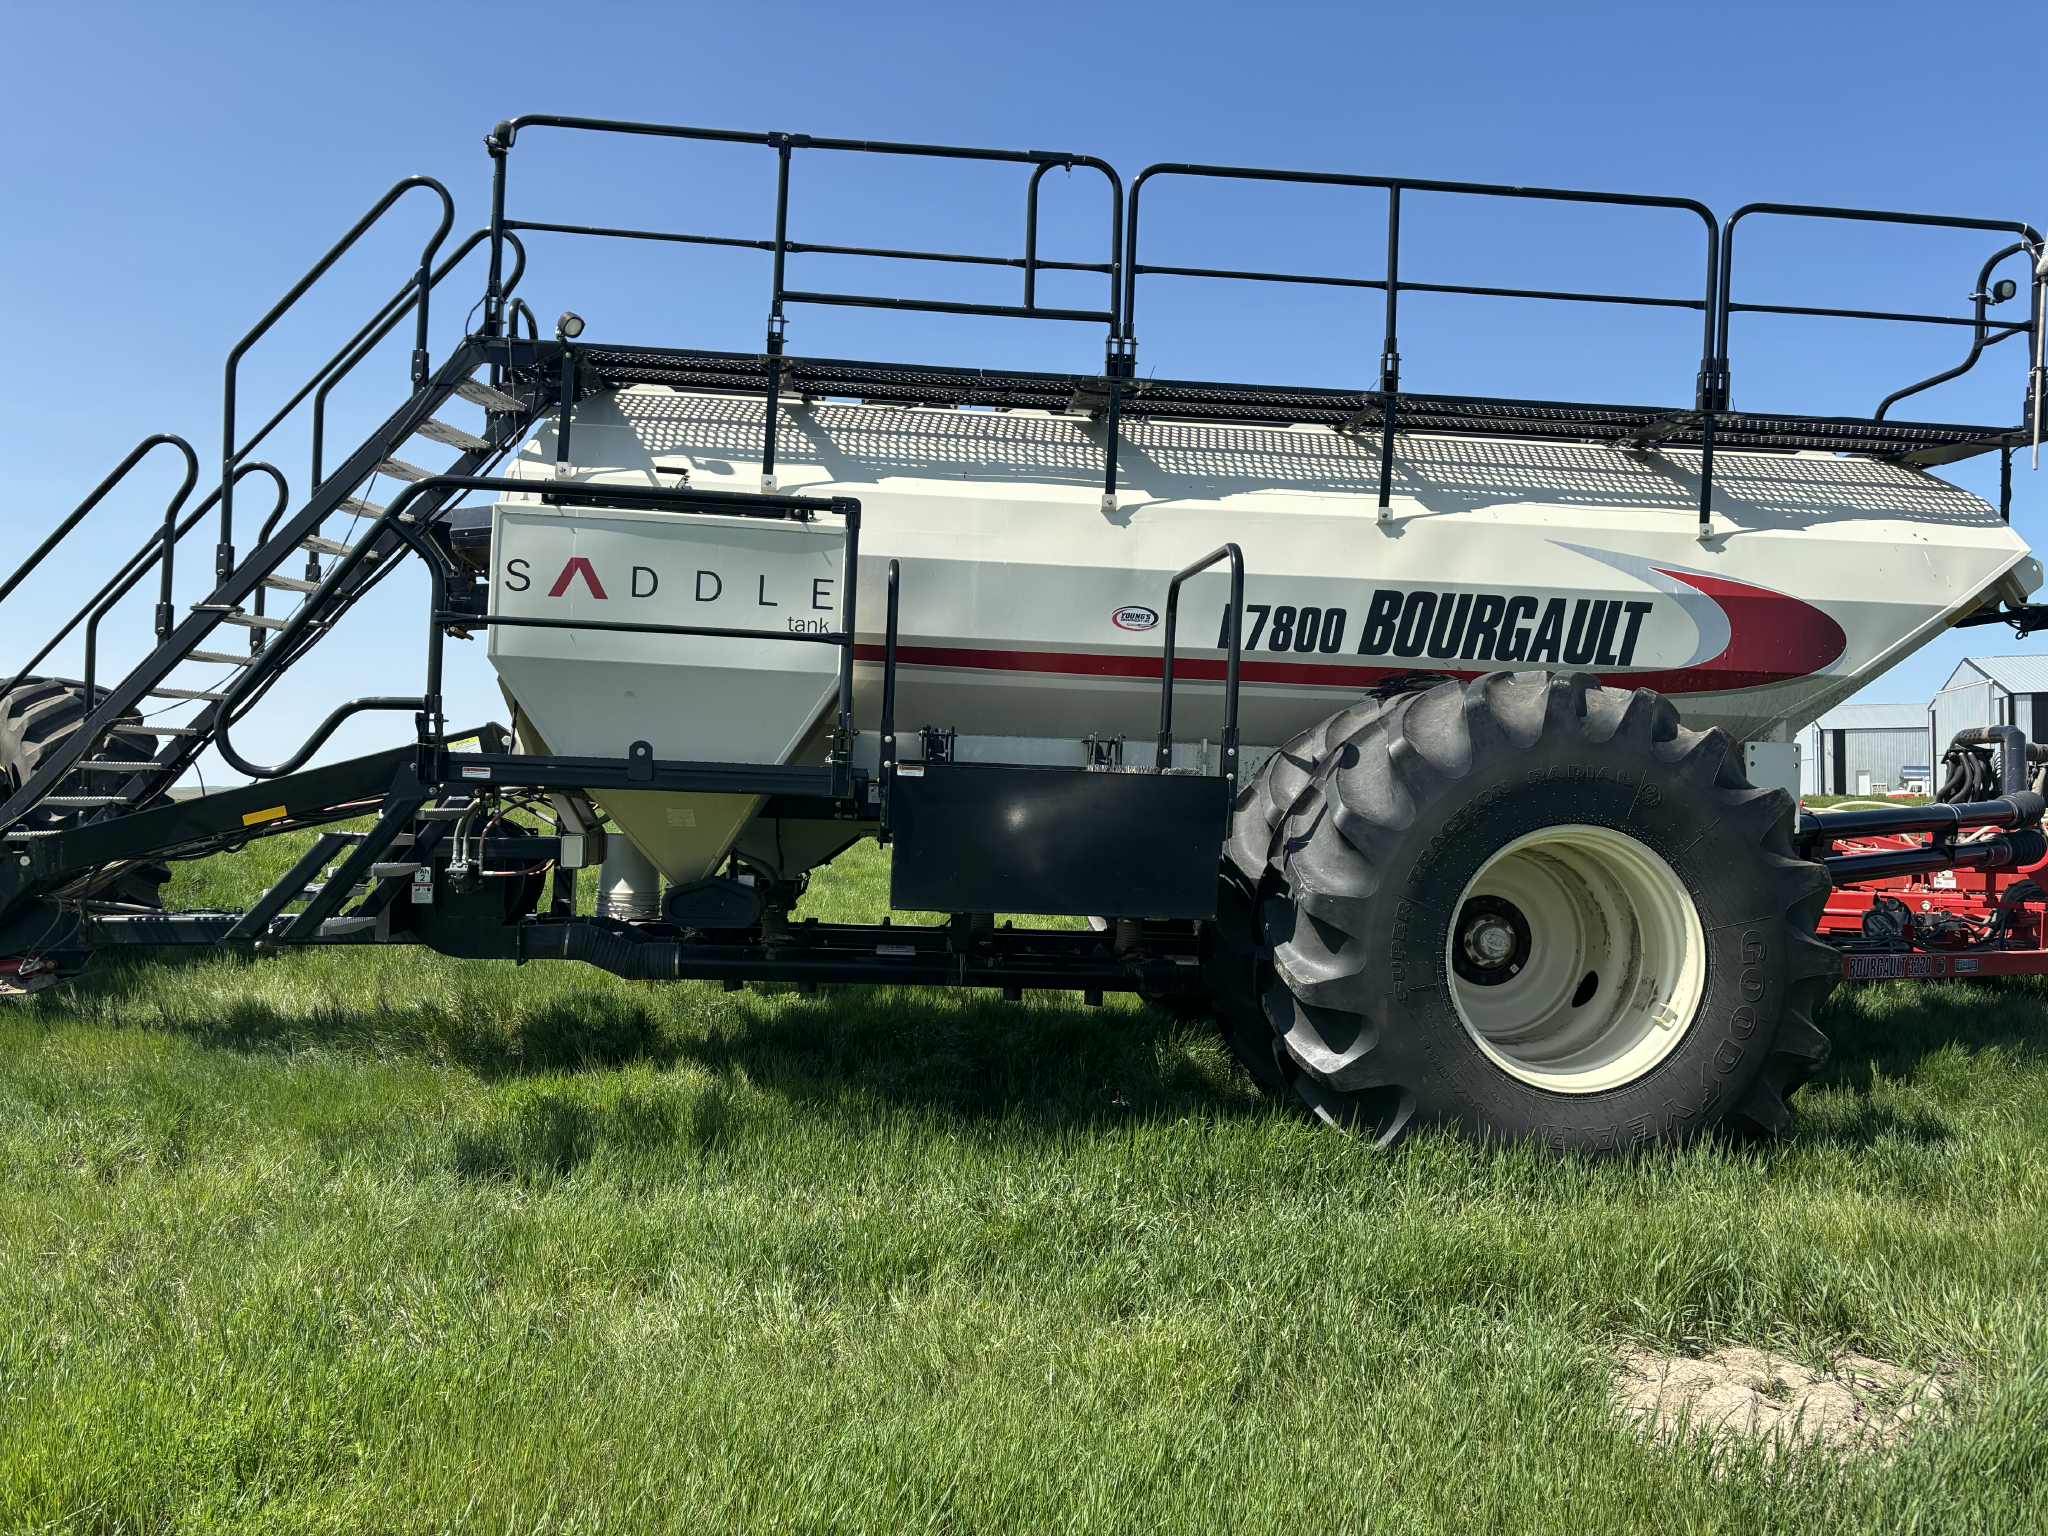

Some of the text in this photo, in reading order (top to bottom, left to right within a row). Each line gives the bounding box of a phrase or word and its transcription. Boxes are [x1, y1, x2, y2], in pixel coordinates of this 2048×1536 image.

[504, 556, 835, 611] SADDLE
[787, 616, 829, 633] tank
[1357, 589, 1653, 667] BOURGAULT
[1847, 956, 1908, 979] BOURGAULT
